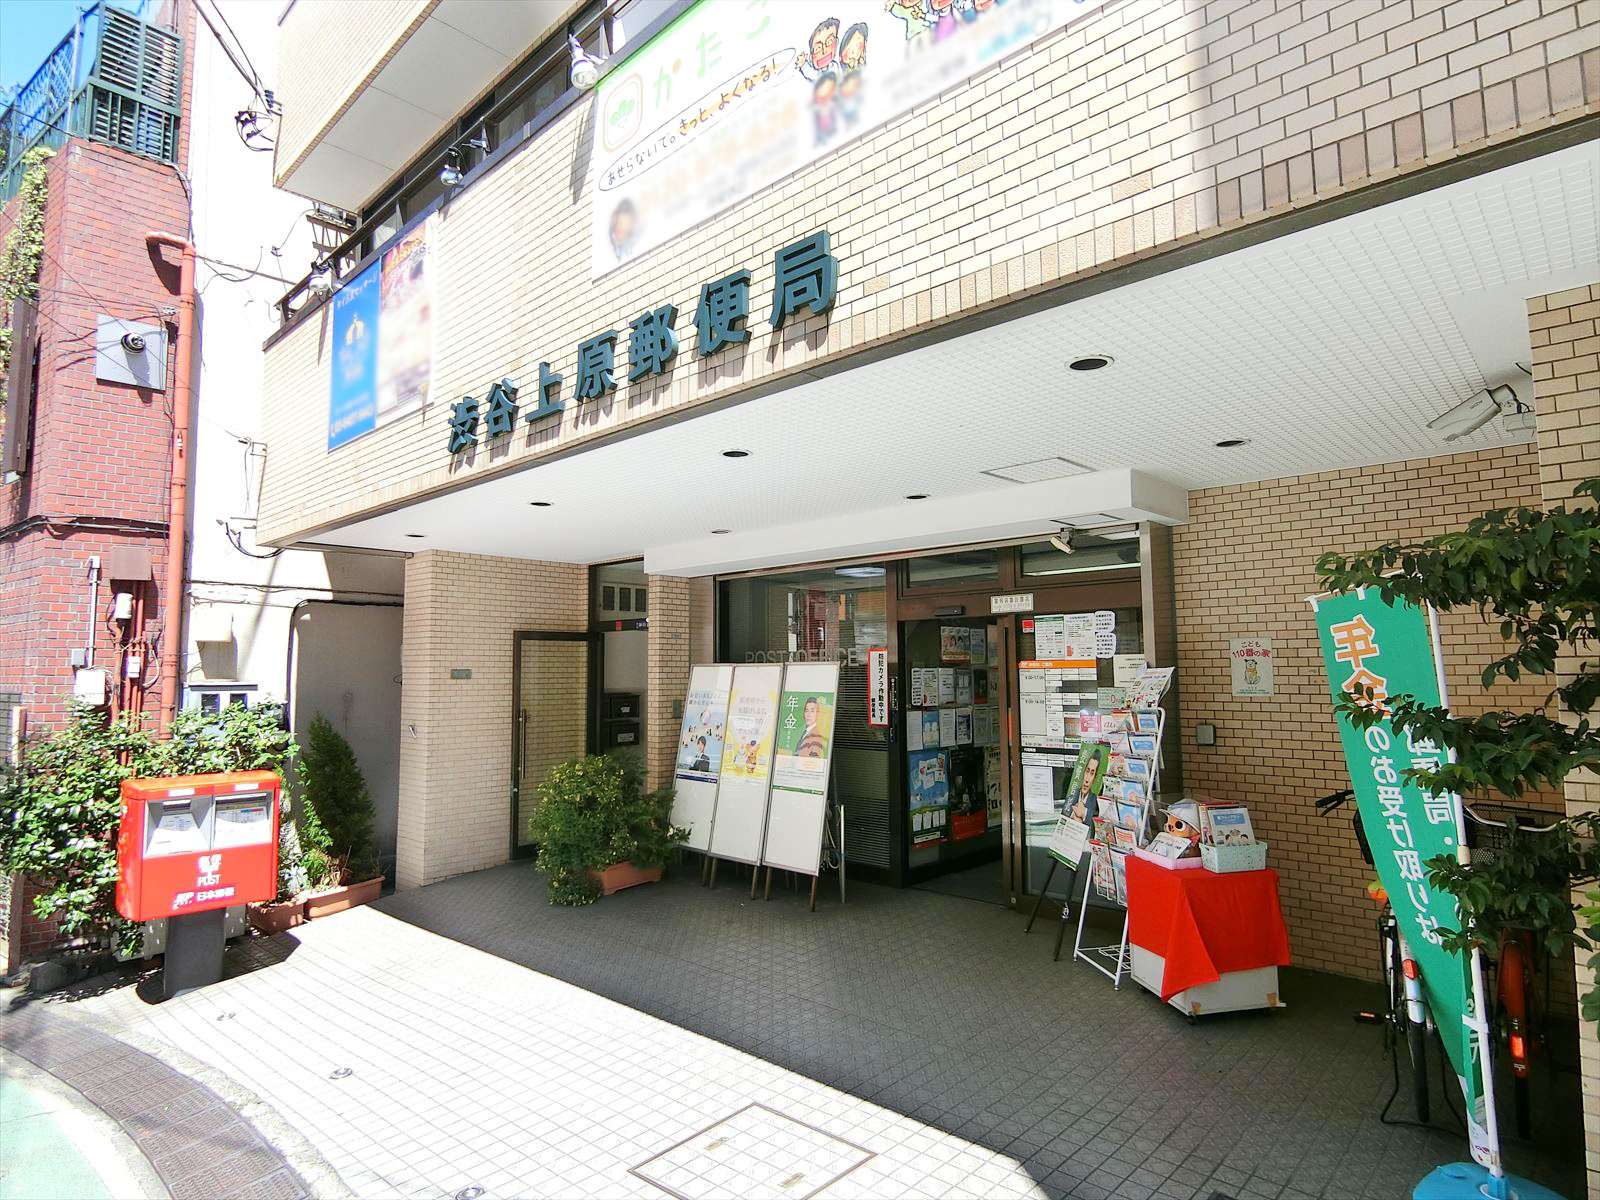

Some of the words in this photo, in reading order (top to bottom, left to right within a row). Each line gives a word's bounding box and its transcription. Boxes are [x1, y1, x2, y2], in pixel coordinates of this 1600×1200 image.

[447, 229, 839, 454] 渋谷上原郵便局
[1241, 640, 1261, 648] こども
[1232, 648, 1271, 658] 110番の家
[784, 695, 799, 729] 年金
[197, 874, 221, 887] POST
